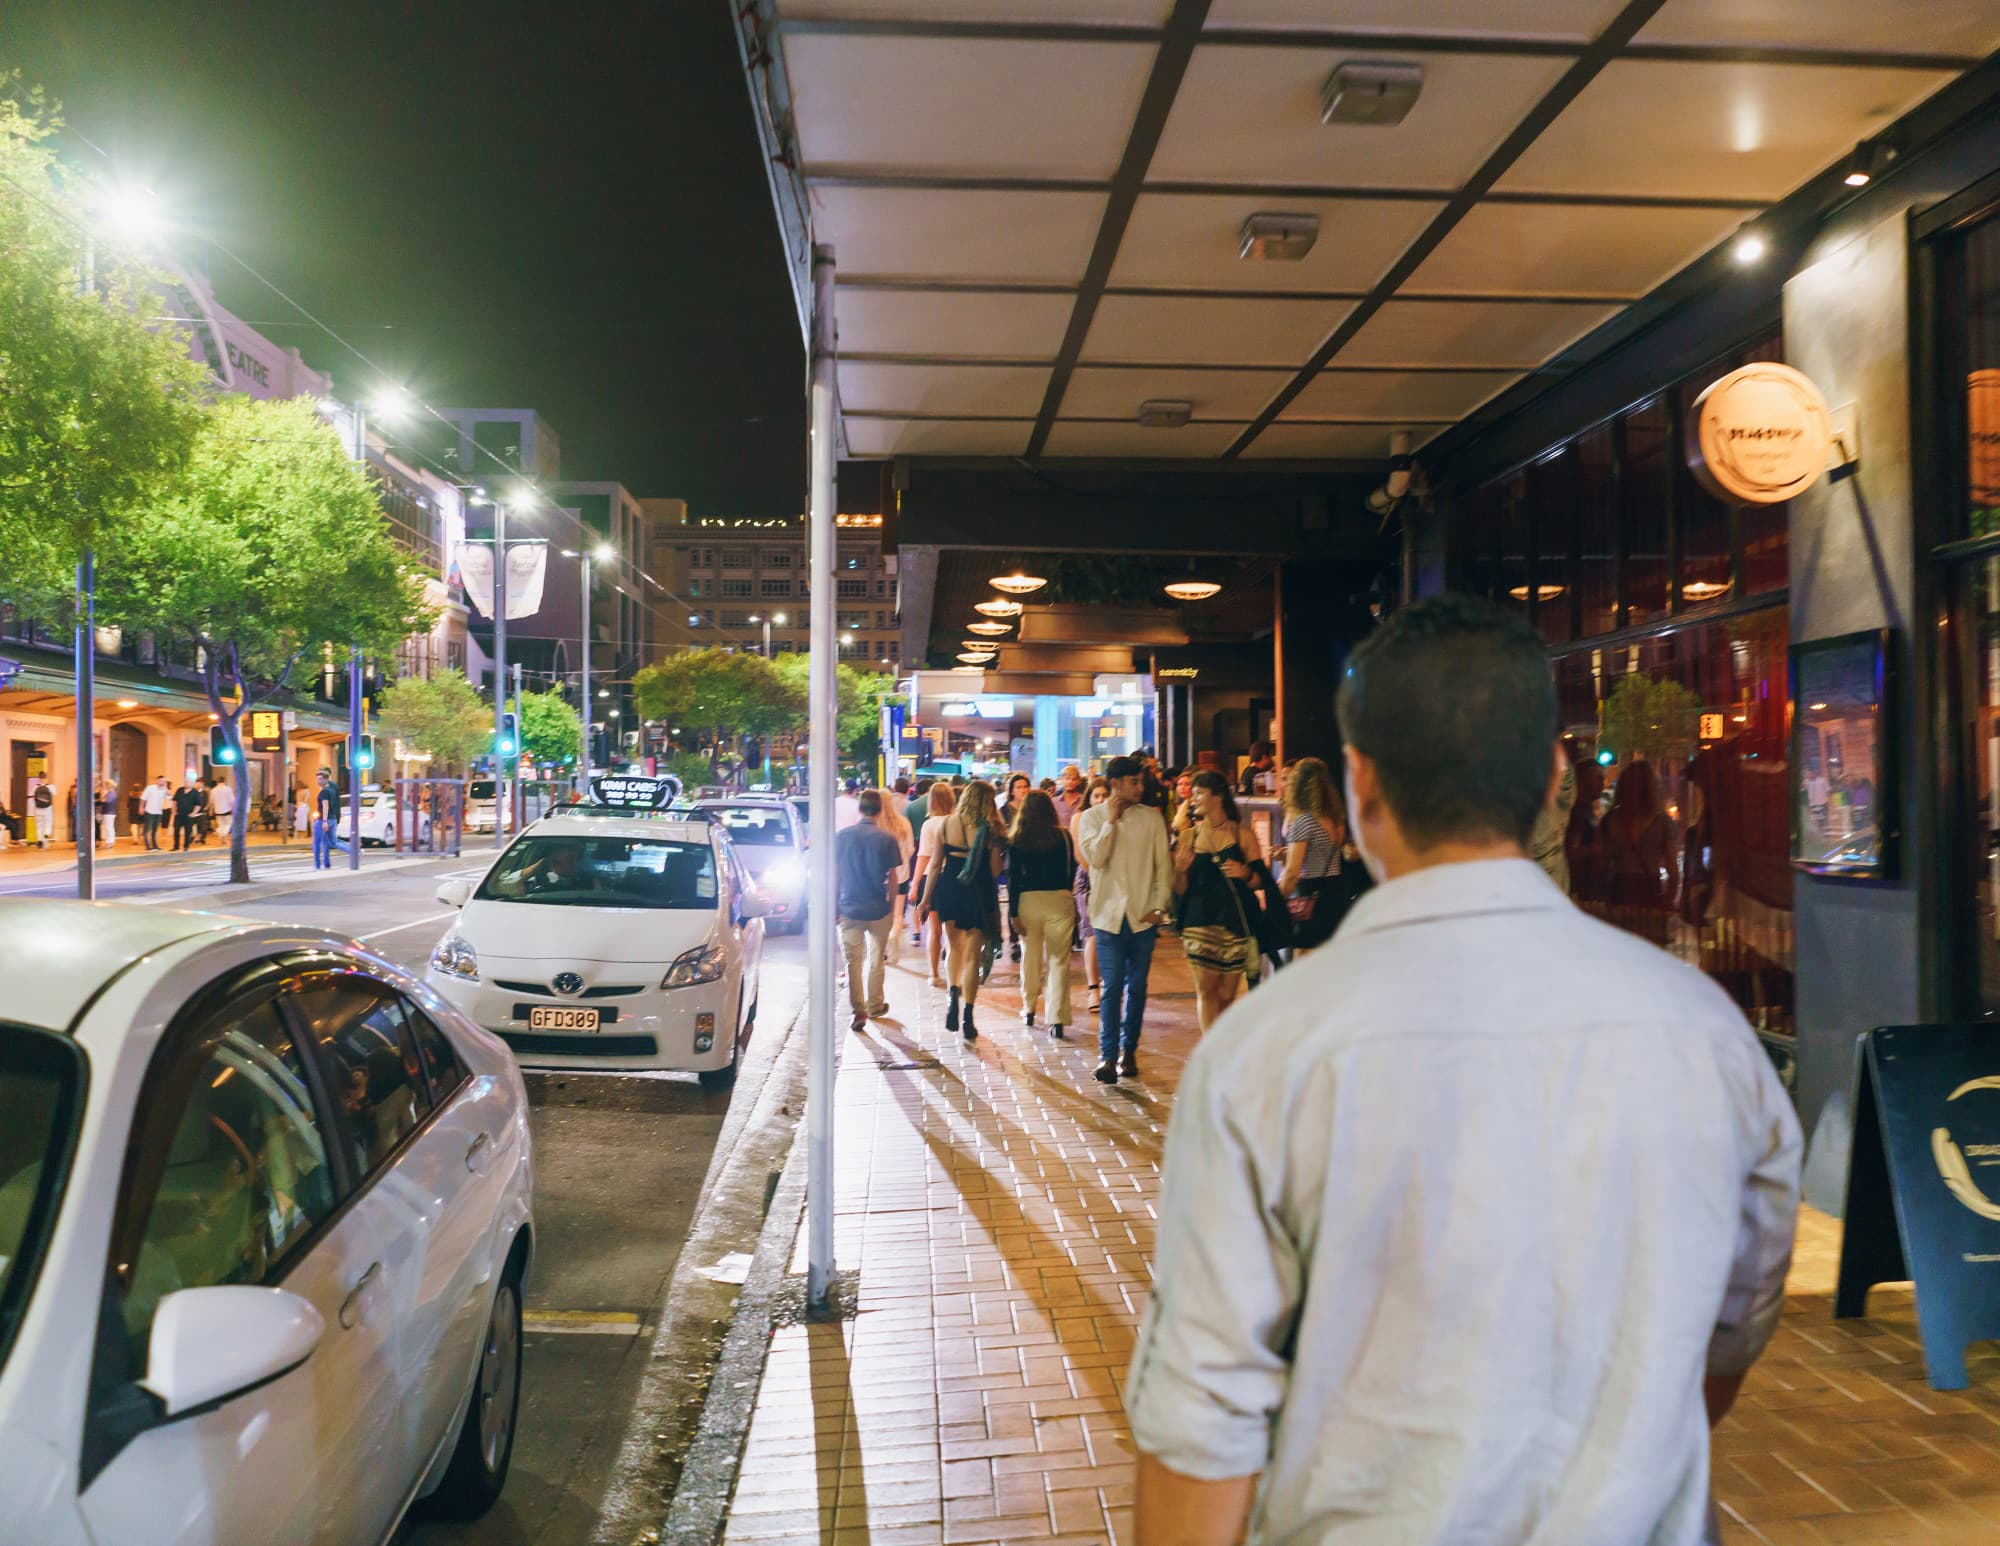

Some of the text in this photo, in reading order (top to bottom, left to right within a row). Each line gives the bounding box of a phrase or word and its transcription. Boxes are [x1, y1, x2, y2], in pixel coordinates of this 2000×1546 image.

[600, 780, 657, 792] KIWI CABS
[533, 1010, 596, 1028] GFD309
